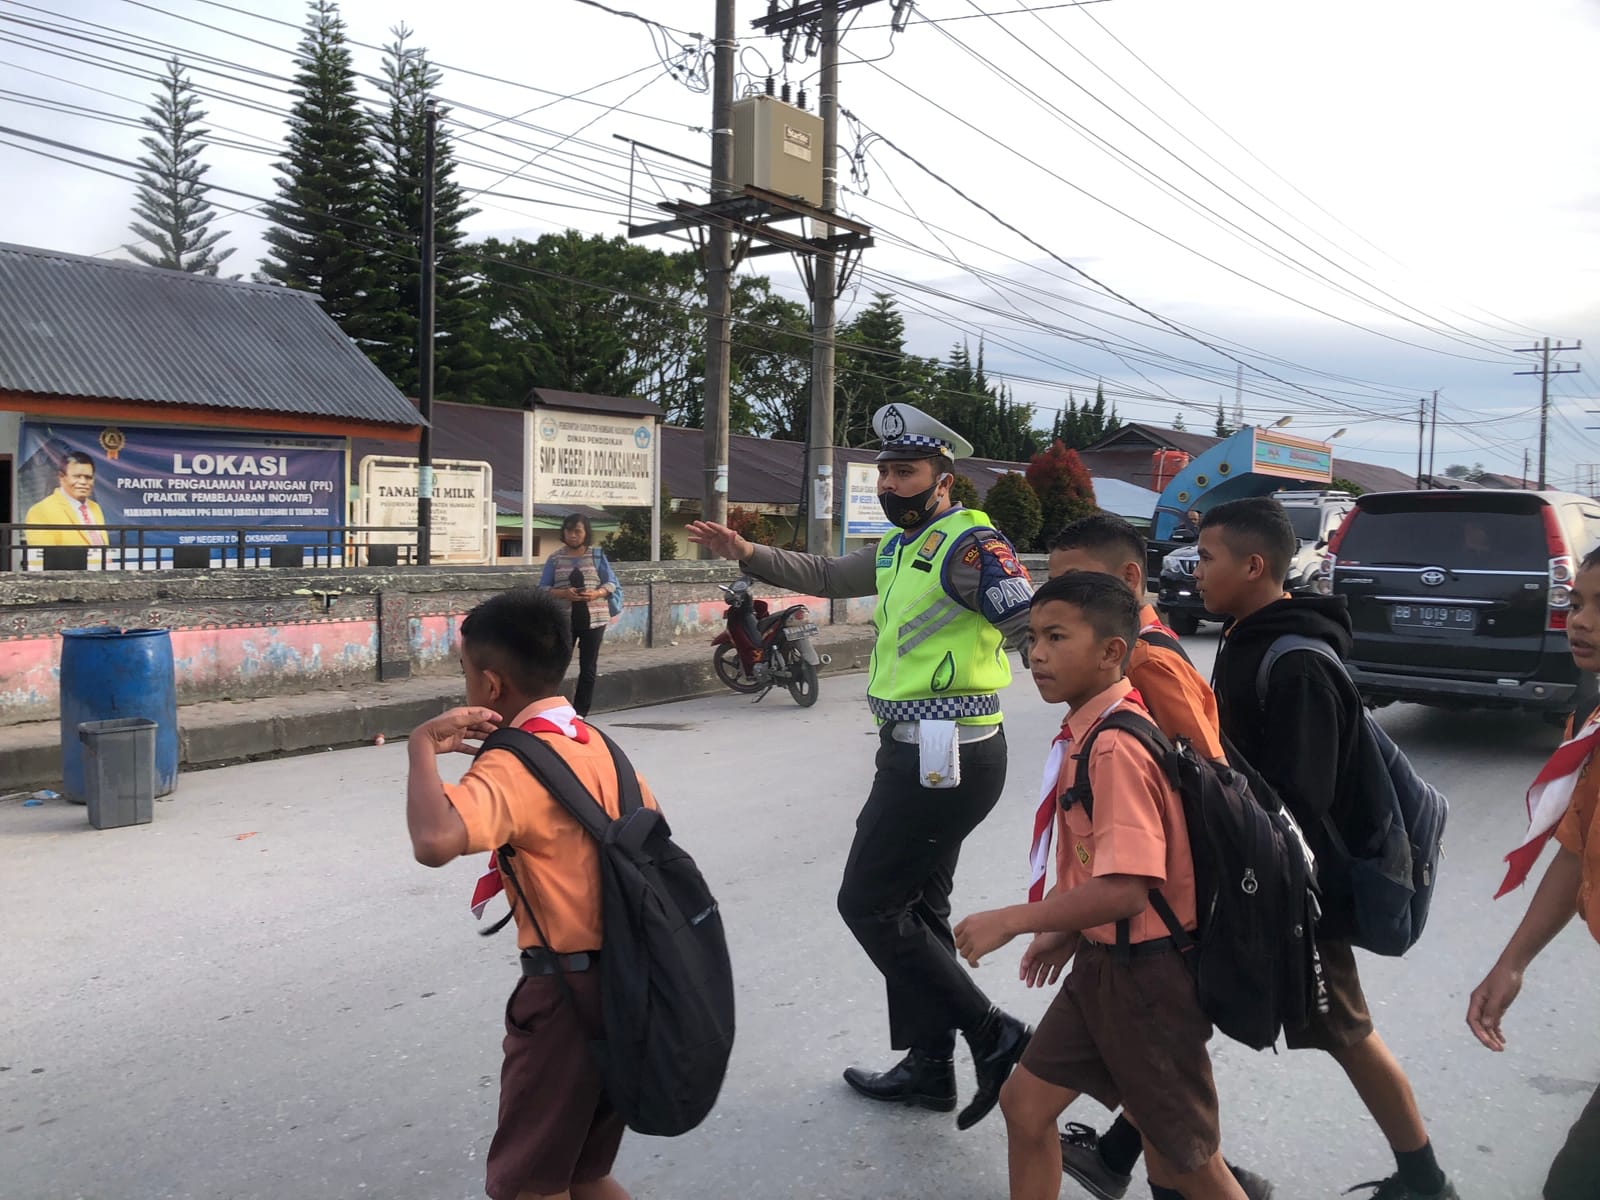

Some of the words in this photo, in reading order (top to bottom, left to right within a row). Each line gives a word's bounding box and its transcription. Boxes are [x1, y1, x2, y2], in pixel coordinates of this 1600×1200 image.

[173, 453, 288, 476] LOKASI
[540, 446, 555, 474] SMP
[558, 447, 585, 475] NEGERI
[587, 450, 592, 476] 2
[593, 450, 649, 479] DOLOKSANGGUL
[117, 478, 163, 489] PRAKTIK
[168, 479, 245, 490] PENGALAMAN
[249, 480, 307, 491] LAPANGAN
[310, 480, 334, 493] (PPL)
[552, 478, 589, 488] KECAMATAN
[143, 492, 188, 504] (PRAKTIK
[191, 492, 265, 503] PEMBELAJARAN
[268, 493, 313, 504] INOVATIF)
[444, 487, 476, 499] MILIK
[179, 535, 195, 544] SMP
[196, 535, 225, 544] NEGERI
[1394, 605, 1411, 618] BB
[1419, 606, 1448, 620] 1019
